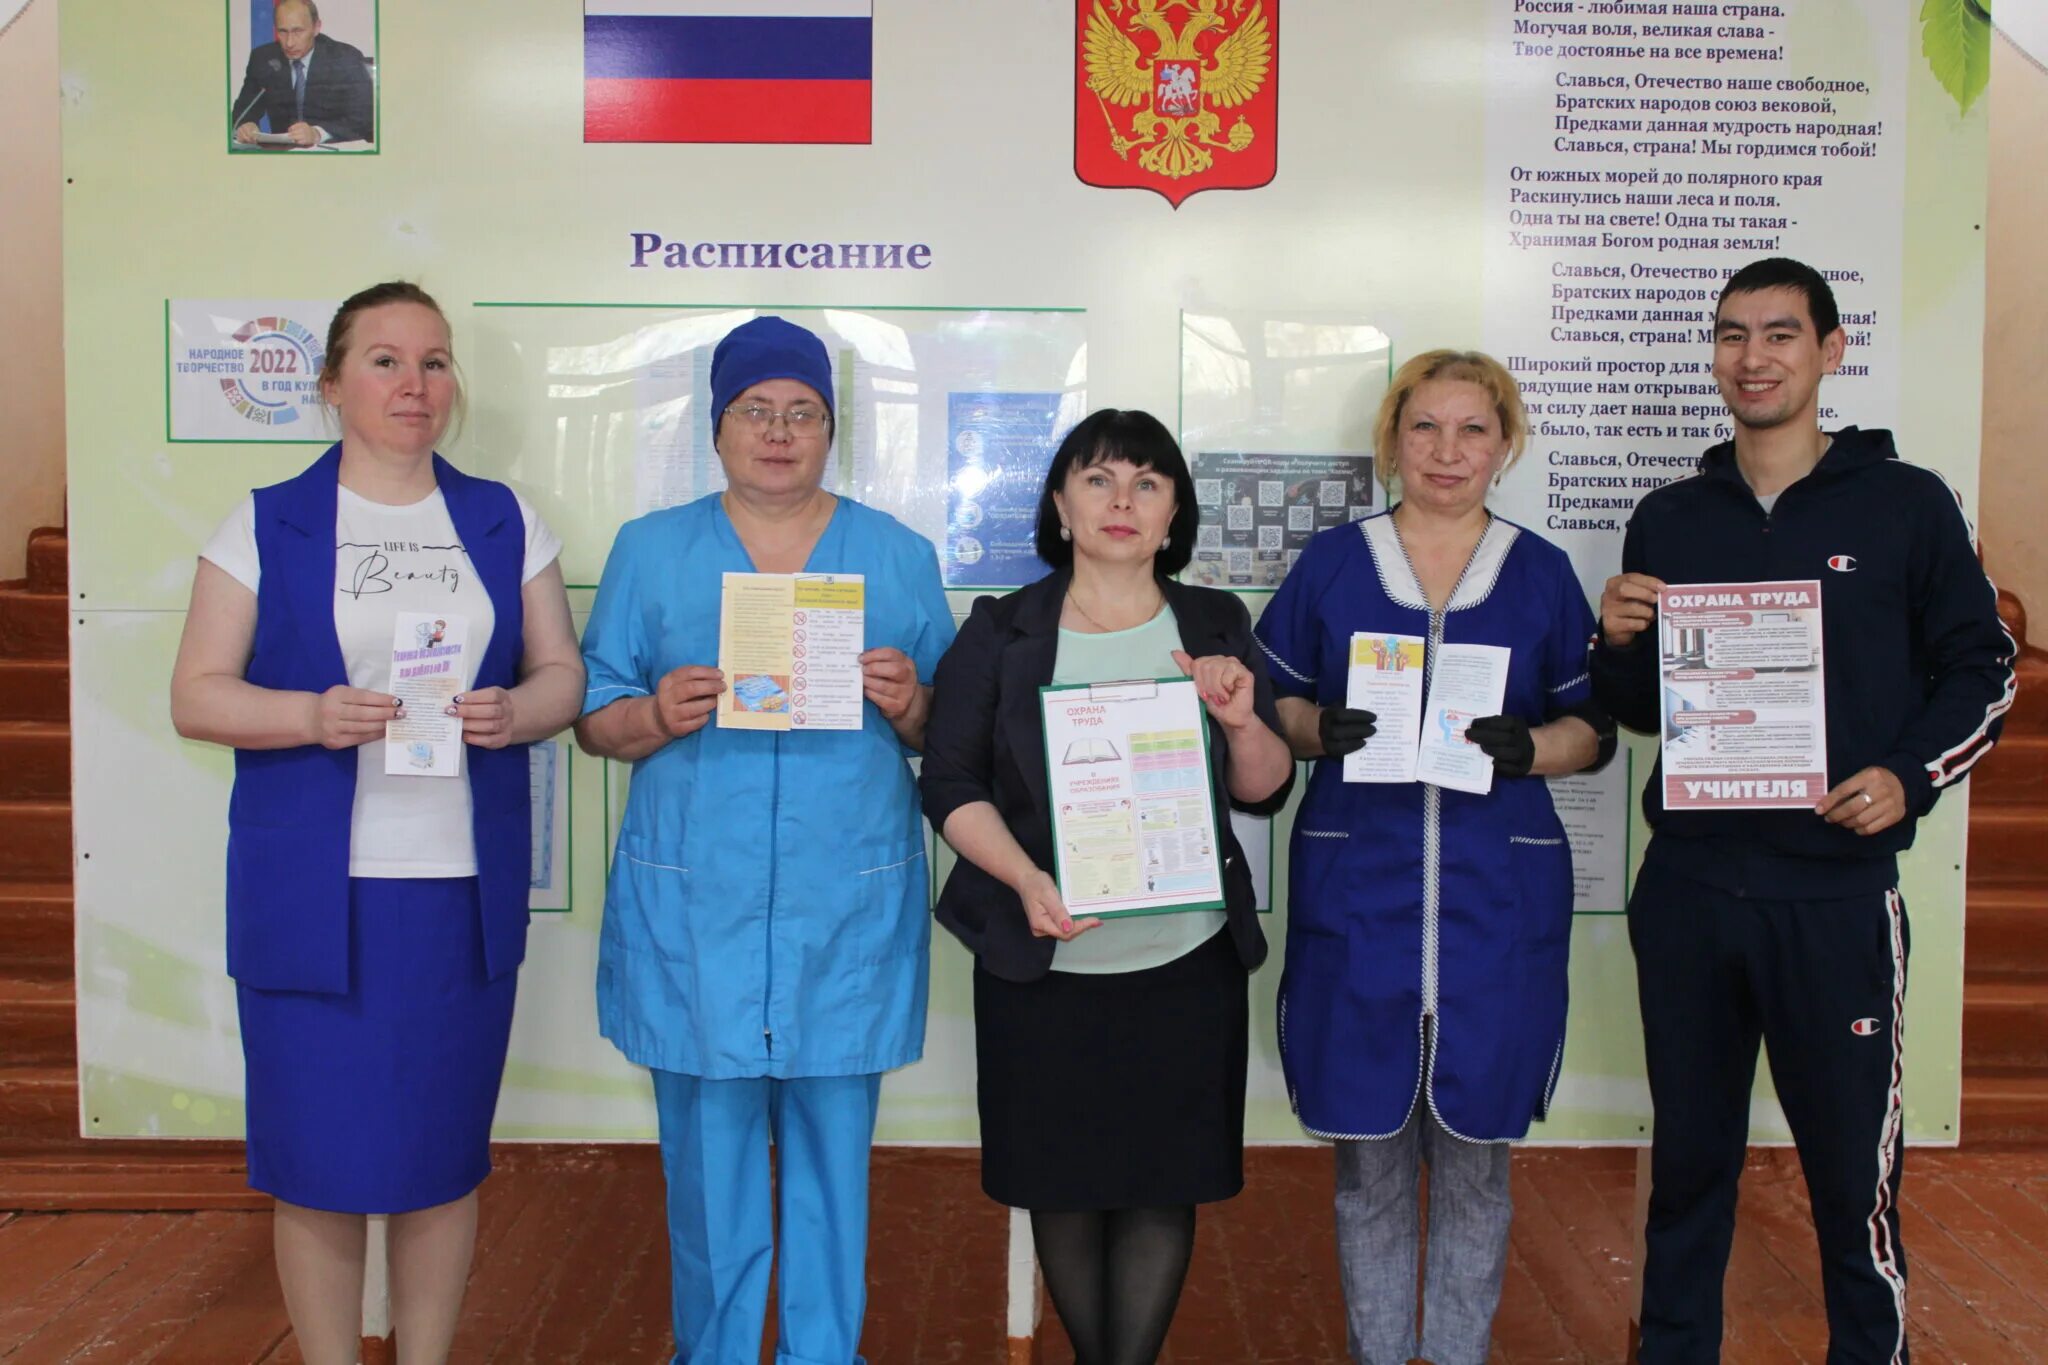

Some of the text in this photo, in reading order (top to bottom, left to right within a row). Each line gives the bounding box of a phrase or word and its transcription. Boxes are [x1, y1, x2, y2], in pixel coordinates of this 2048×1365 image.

[1513, 0, 1574, 14] Россия
[1587, 0, 1668, 15] любимая
[1672, 3, 1719, 16] наша
[1722, 4, 1785, 21] страна.
[1513, 19, 1588, 39] Могучая
[1591, 24, 1638, 40] воля,
[1641, 25, 1713, 38] великая
[1716, 26, 1765, 39] слава
[1512, 41, 1784, 64] Твое достоянье на все времена!
[1555, 71, 1870, 96] Славься, Отечество наше свободное,
[1555, 93, 1837, 117] Братских народов союз вековой,
[1554, 115, 1882, 139] Предками данная мудрость народная!
[1554, 136, 1877, 159] Славься, страна! Мы гордимся тобой!
[1510, 166, 1823, 190] От южных морей до полярного края
[1510, 187, 1781, 208] Раскинулись наши леса и поля.
[1509, 209, 1553, 227] Одна
[1556, 214, 1581, 226] ты
[1584, 214, 1606, 226] на
[1609, 211, 1660, 227] свете!
[1664, 211, 1709, 229] Одна
[1711, 216, 1736, 228] ты
[1739, 217, 1788, 229] такая
[630, 233, 932, 269] Расписание
[1509, 232, 1780, 253] Хранимая Богом родная земля!
[1552, 262, 1626, 281] Славься,
[1630, 262, 1718, 280] Отечество
[1551, 283, 1632, 303] Братских
[1635, 288, 1706, 304] народов
[1551, 305, 1639, 324] Предками
[1641, 310, 1704, 324] данная
[1550, 326, 1625, 345] Славься,
[1629, 329, 1692, 346] страна!
[188, 348, 245, 360] НАРОДНОЕ
[249, 349, 297, 374] 2022
[176, 362, 245, 373] ТВОРЧЕСТВО
[1508, 356, 1592, 375] Широкий
[1596, 361, 1666, 377] простор
[1668, 362, 1700, 376] для
[262, 380, 269, 391] В
[272, 380, 292, 393] ГОД
[1517, 381, 1720, 398] рядущие нам открываю
[1546, 403, 1587, 419] силу
[1589, 403, 1628, 417] дает
[1631, 404, 1678, 417] наша
[1681, 405, 1731, 420] верно
[1540, 420, 1590, 439] было,
[1593, 425, 1624, 437] так
[1626, 425, 1663, 437] есть
[1666, 426, 1678, 438] и
[1680, 426, 1711, 438] так
[1548, 450, 1622, 470] Славься,
[1547, 472, 1628, 491] Братских
[1547, 493, 1635, 513] Предками
[1546, 514, 1621, 533] Славься,
[383, 541, 420, 553] LIFE IS
[340, 550, 460, 600] Beauty
[1667, 591, 1811, 608] ОХРАНА ТРУДА
[1066, 705, 1107, 717] ОХРАНА
[1072, 717, 1103, 727] ТРУДА
[1683, 779, 1808, 799] УЧИТЕЛЯ
